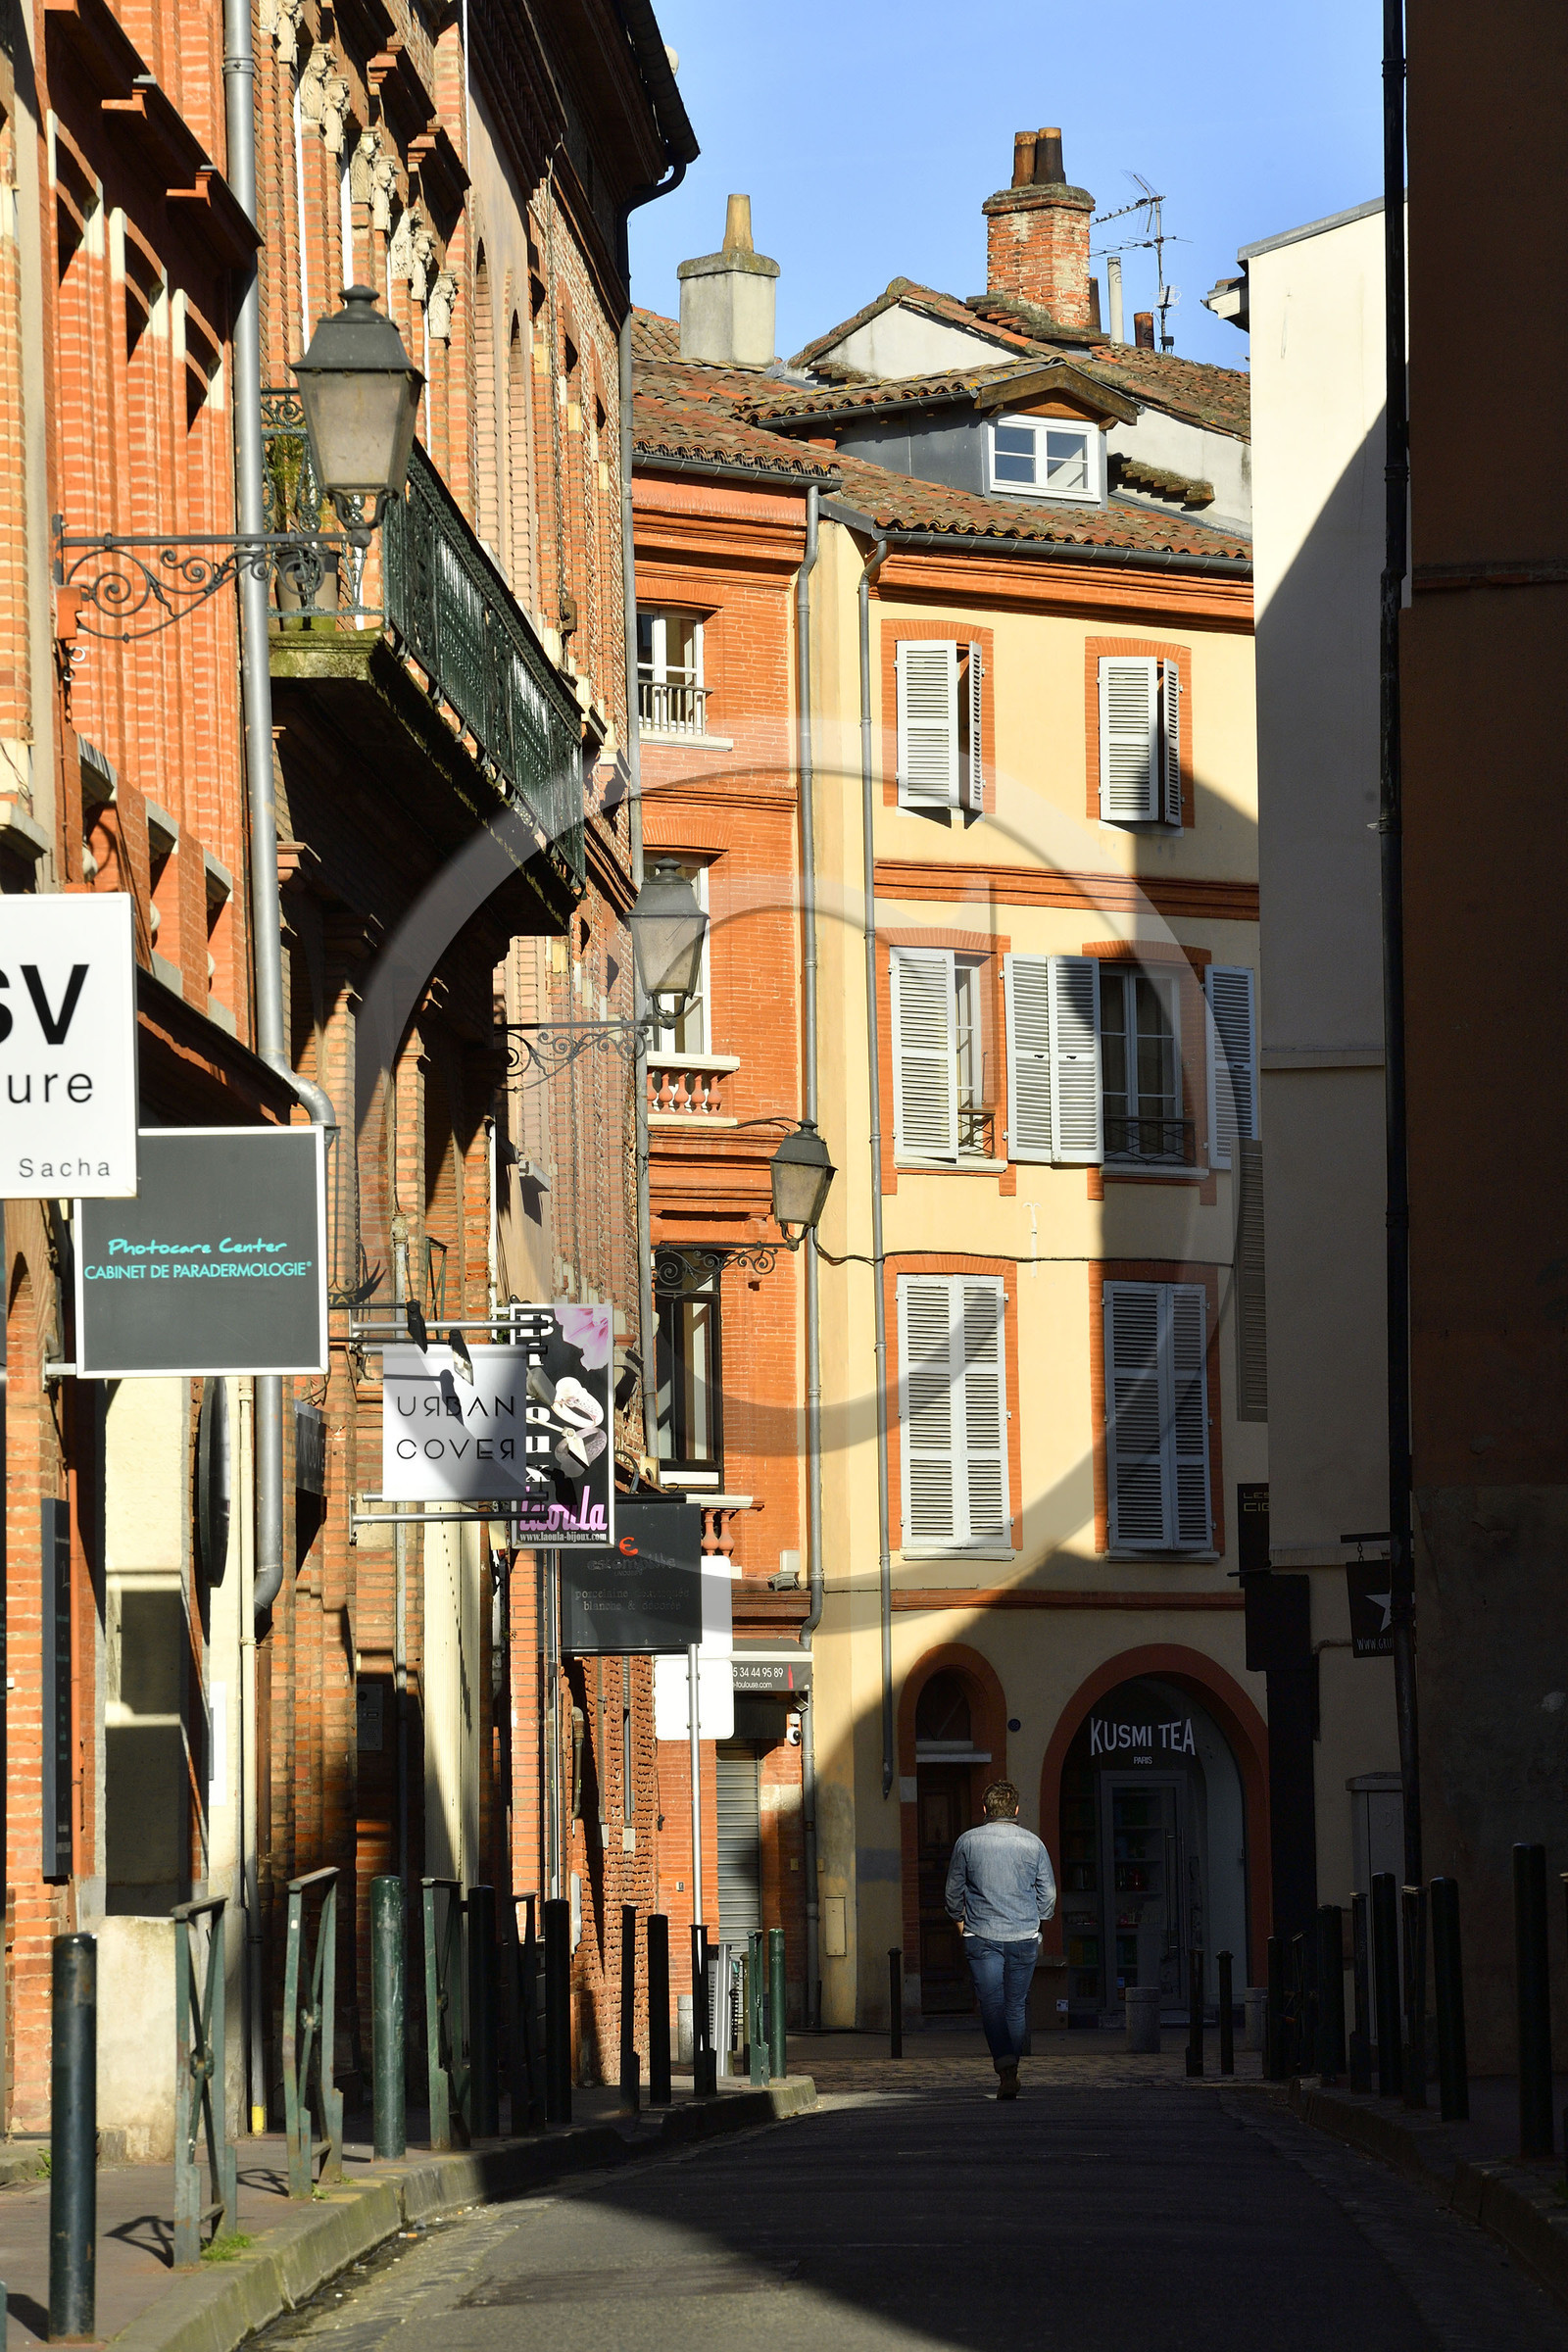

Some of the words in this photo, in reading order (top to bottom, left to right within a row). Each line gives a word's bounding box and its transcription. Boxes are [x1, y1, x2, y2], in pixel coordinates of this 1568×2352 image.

[0, 964, 90, 1045] V
[8, 1073, 93, 1103] ure
[19, 1157, 111, 1178] Sacha
[108, 1238, 212, 1255] Photocare
[219, 1237, 287, 1253] Center
[84, 1265, 147, 1279] CABINET
[150, 1264, 170, 1278] DE
[397, 1396, 515, 1417] URBAN
[397, 1438, 514, 1460] COVER
[519, 1532, 607, 1543] www.laoula-bijoux.com
[627, 1599, 636, 1610] &
[739, 1667, 749, 1677] 34
[751, 1667, 760, 1677] 44
[761, 1667, 772, 1677] 95
[773, 1667, 784, 1678] 89
[1091, 1717, 1152, 1756] KUSMI
[1157, 1718, 1196, 1756] TEA
